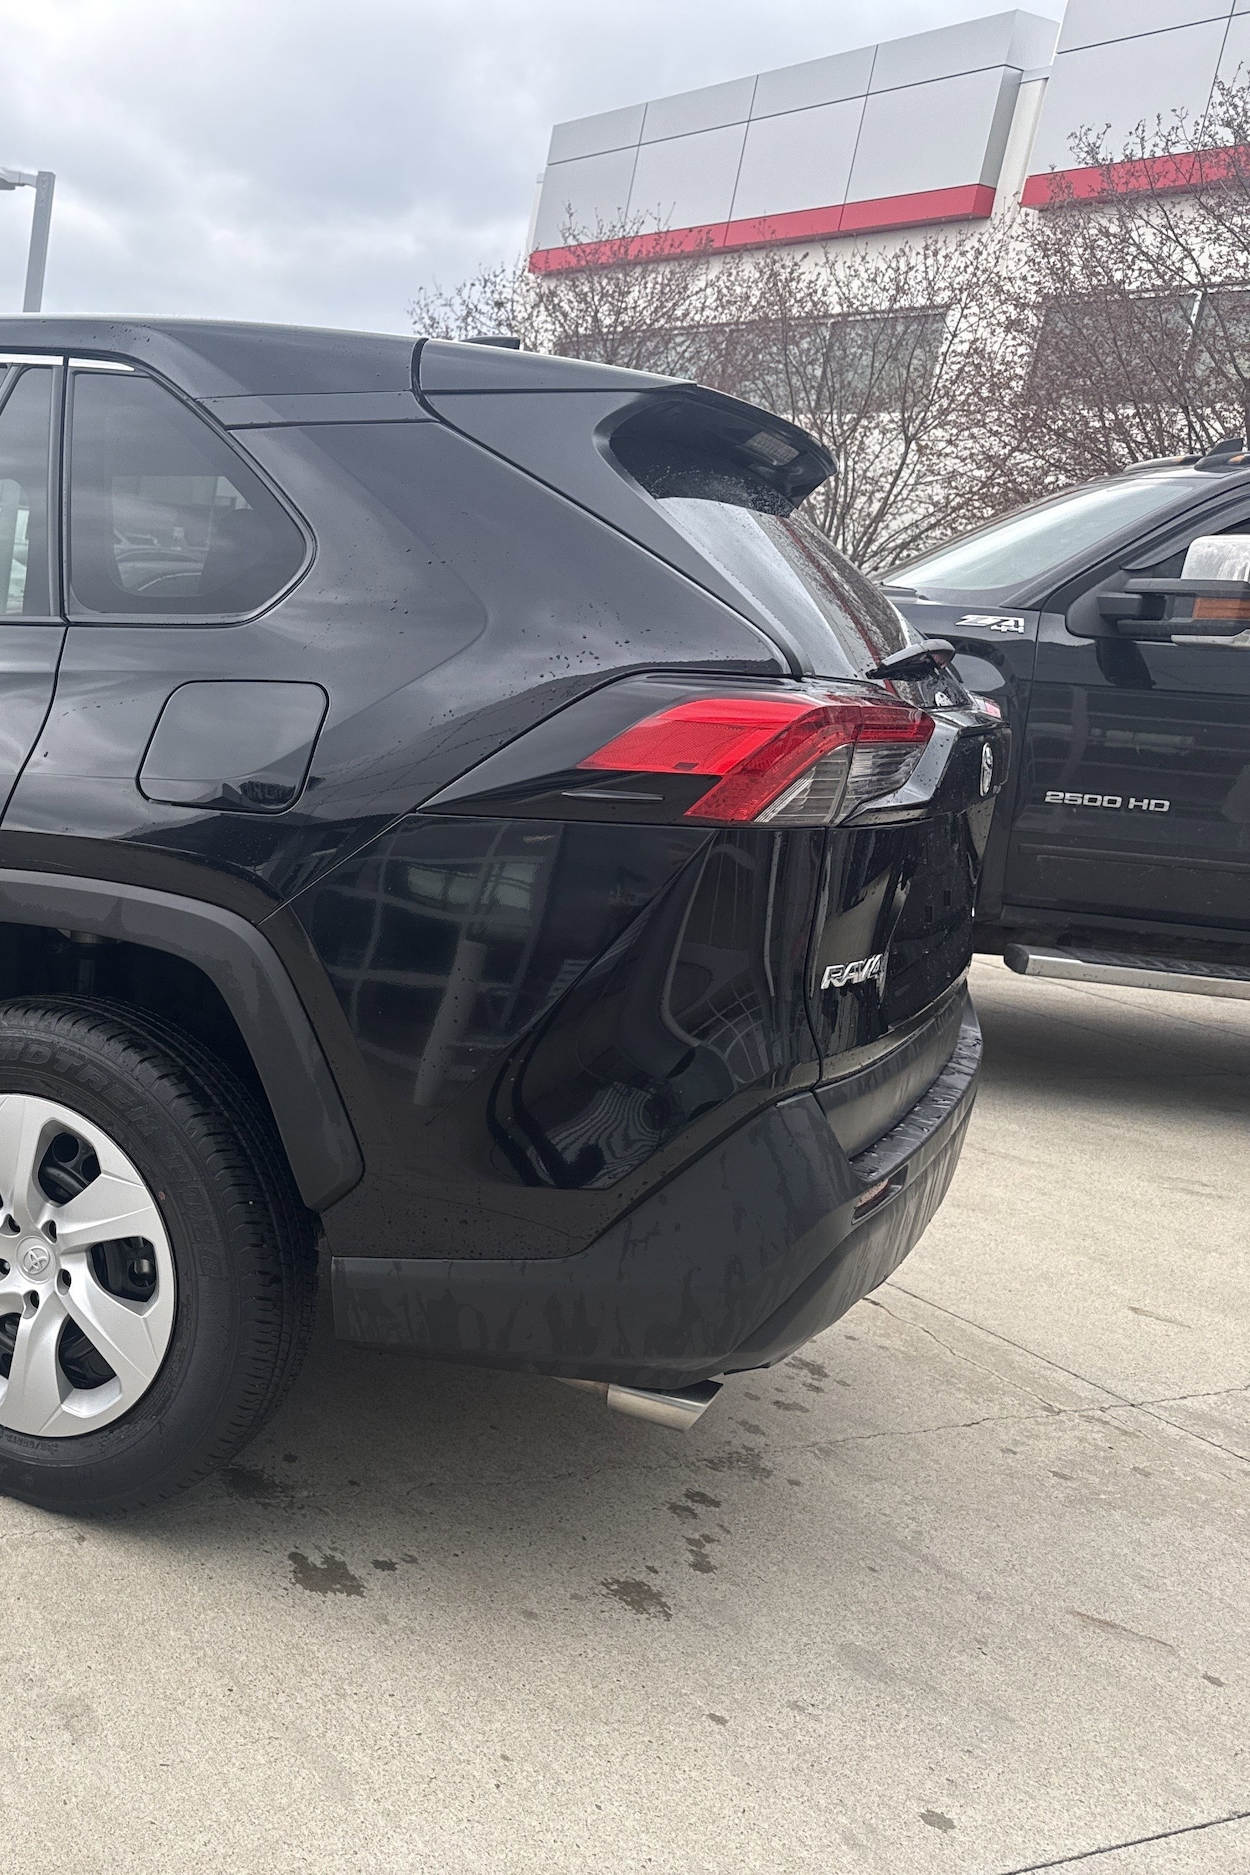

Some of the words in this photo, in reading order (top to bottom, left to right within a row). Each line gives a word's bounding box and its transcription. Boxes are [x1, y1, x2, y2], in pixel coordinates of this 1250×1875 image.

[1044, 790, 1123, 809] 2500
[1127, 797, 1171, 812] HD
[820, 953, 883, 990] RAV4
